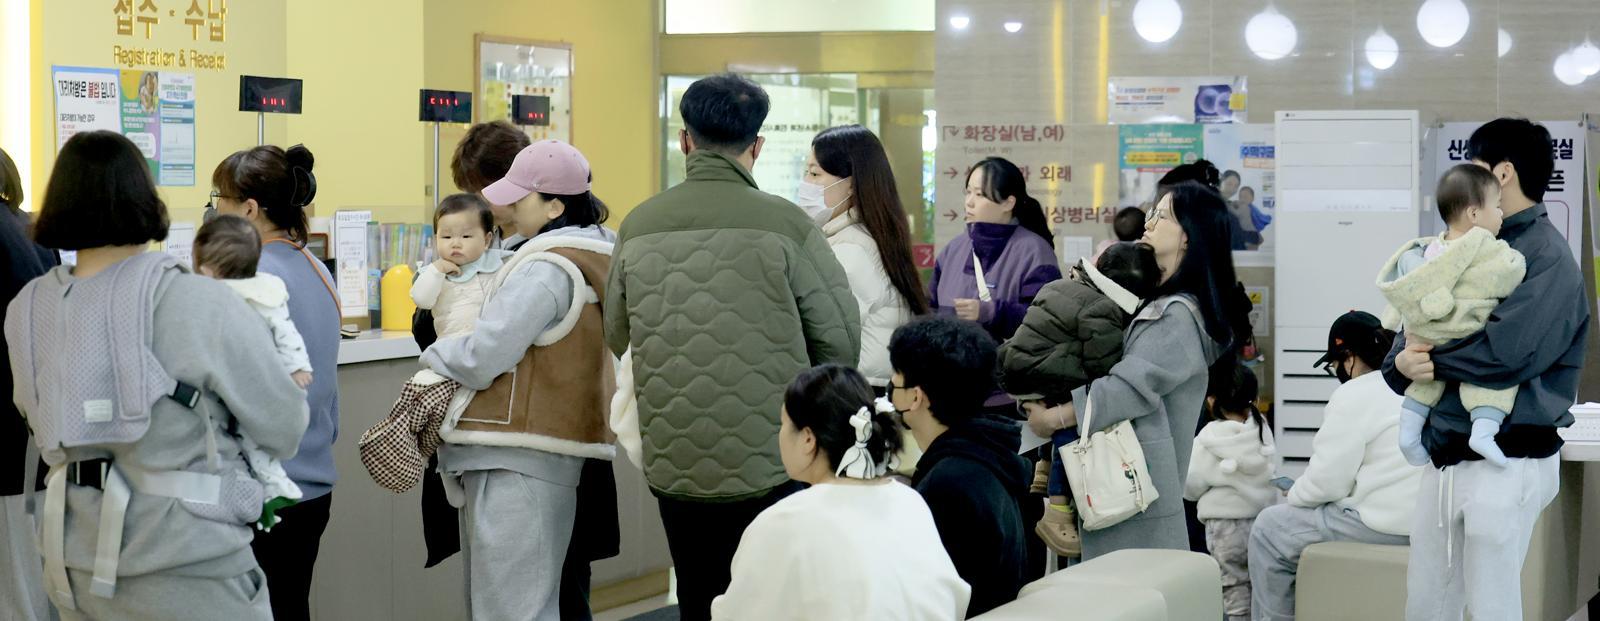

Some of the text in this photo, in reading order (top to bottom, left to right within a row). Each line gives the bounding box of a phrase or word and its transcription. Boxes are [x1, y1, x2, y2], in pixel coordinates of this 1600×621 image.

[113, 0, 160, 39] 접수
[185, 0, 228, 42] 수납
[114, 45, 225, 72] Registration & Receipt
[963, 125, 1065, 142] 화장실(남,여)
[1040, 165, 1072, 182] 외래
